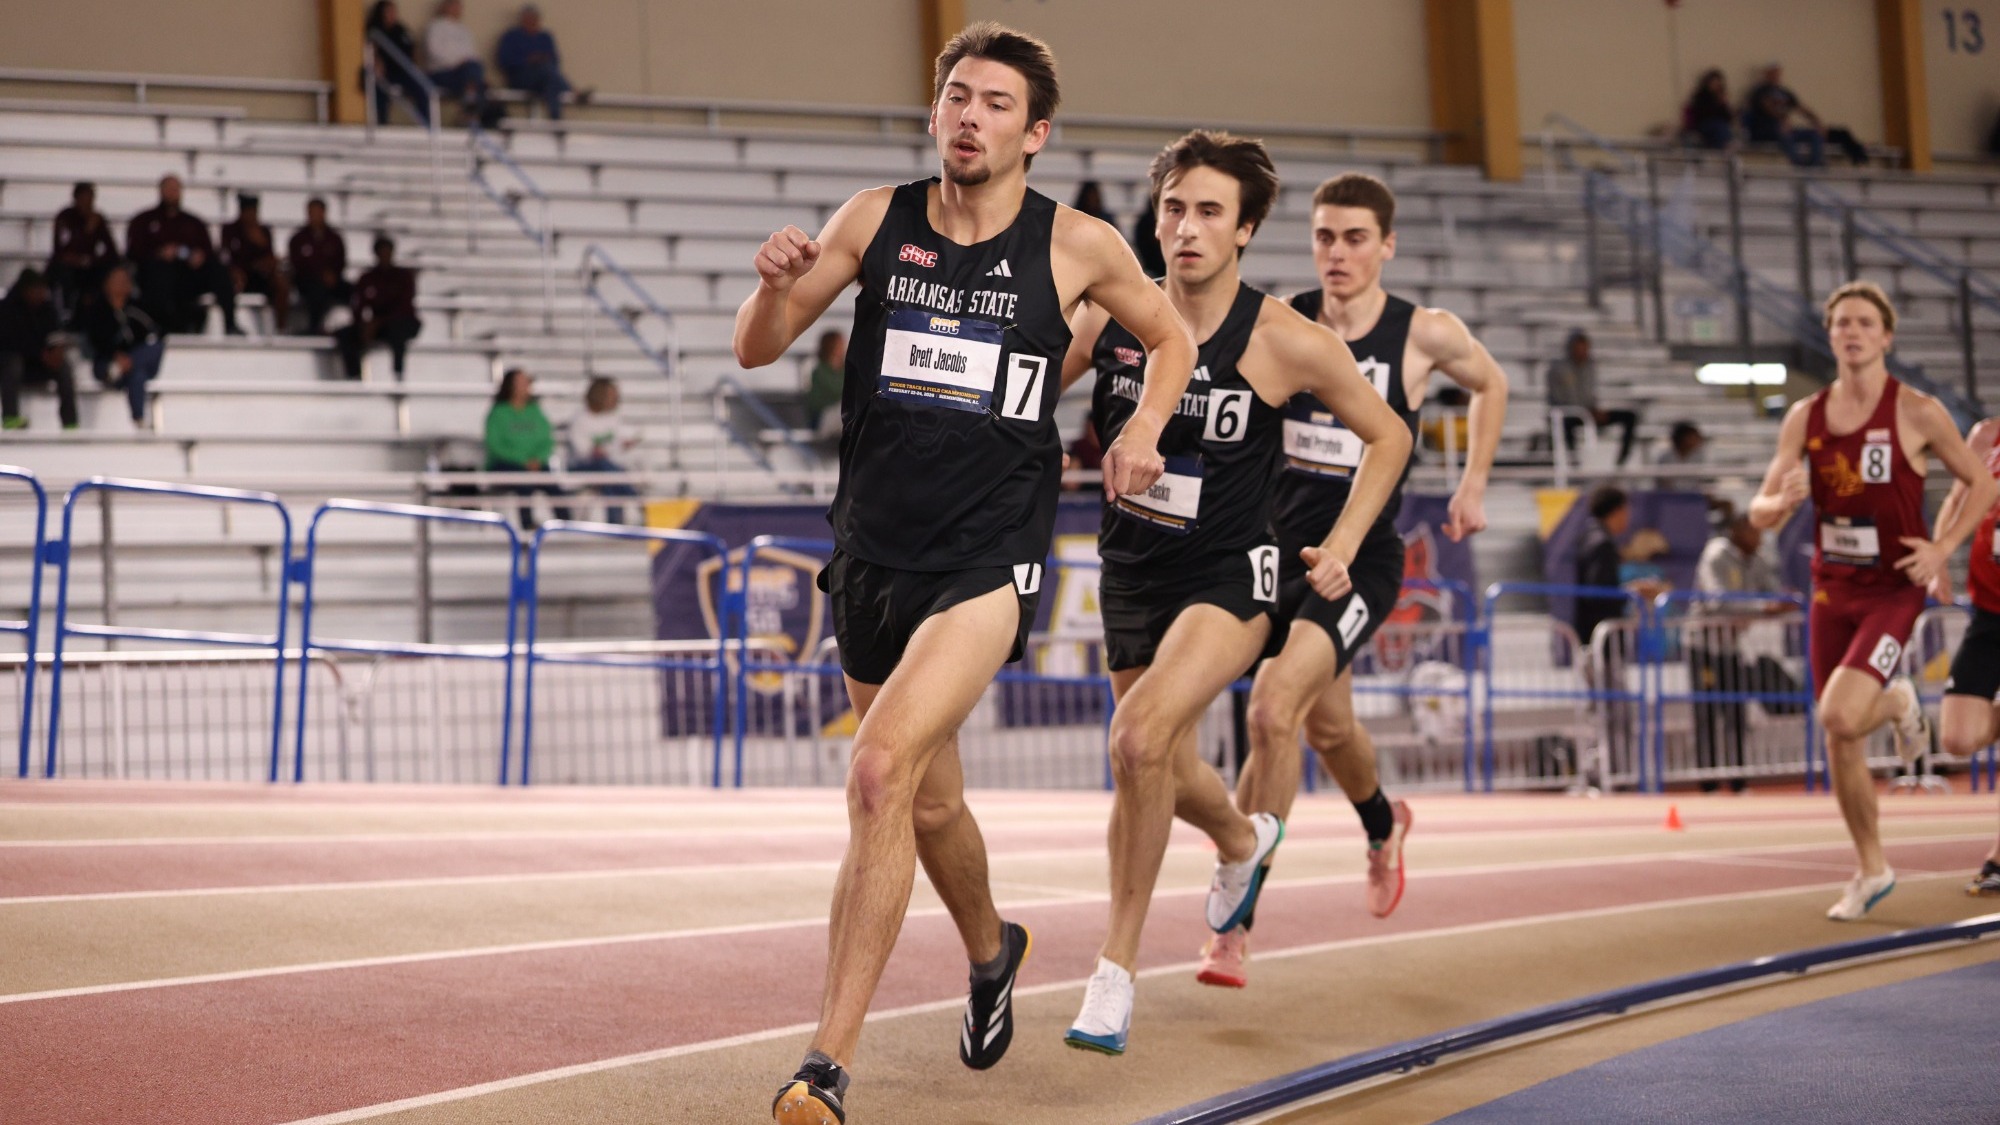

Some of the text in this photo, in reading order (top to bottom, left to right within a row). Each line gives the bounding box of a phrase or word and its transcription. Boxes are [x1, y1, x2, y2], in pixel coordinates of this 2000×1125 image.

[1941, 8, 1985, 54] 13
[899, 244, 938, 268] SBC
[887, 275, 1018, 319] ARKANSAS STATE
[929, 317, 960, 335] SBC
[909, 344, 968, 374] Brett Jacobs
[1014, 358, 1041, 416] 7
[1111, 374, 1144, 403] ARKAN
[1215, 393, 1241, 439] 6
[1868, 448, 1884, 479] 8
[1260, 549, 1274, 598] 6
[1877, 642, 1898, 670] 8
